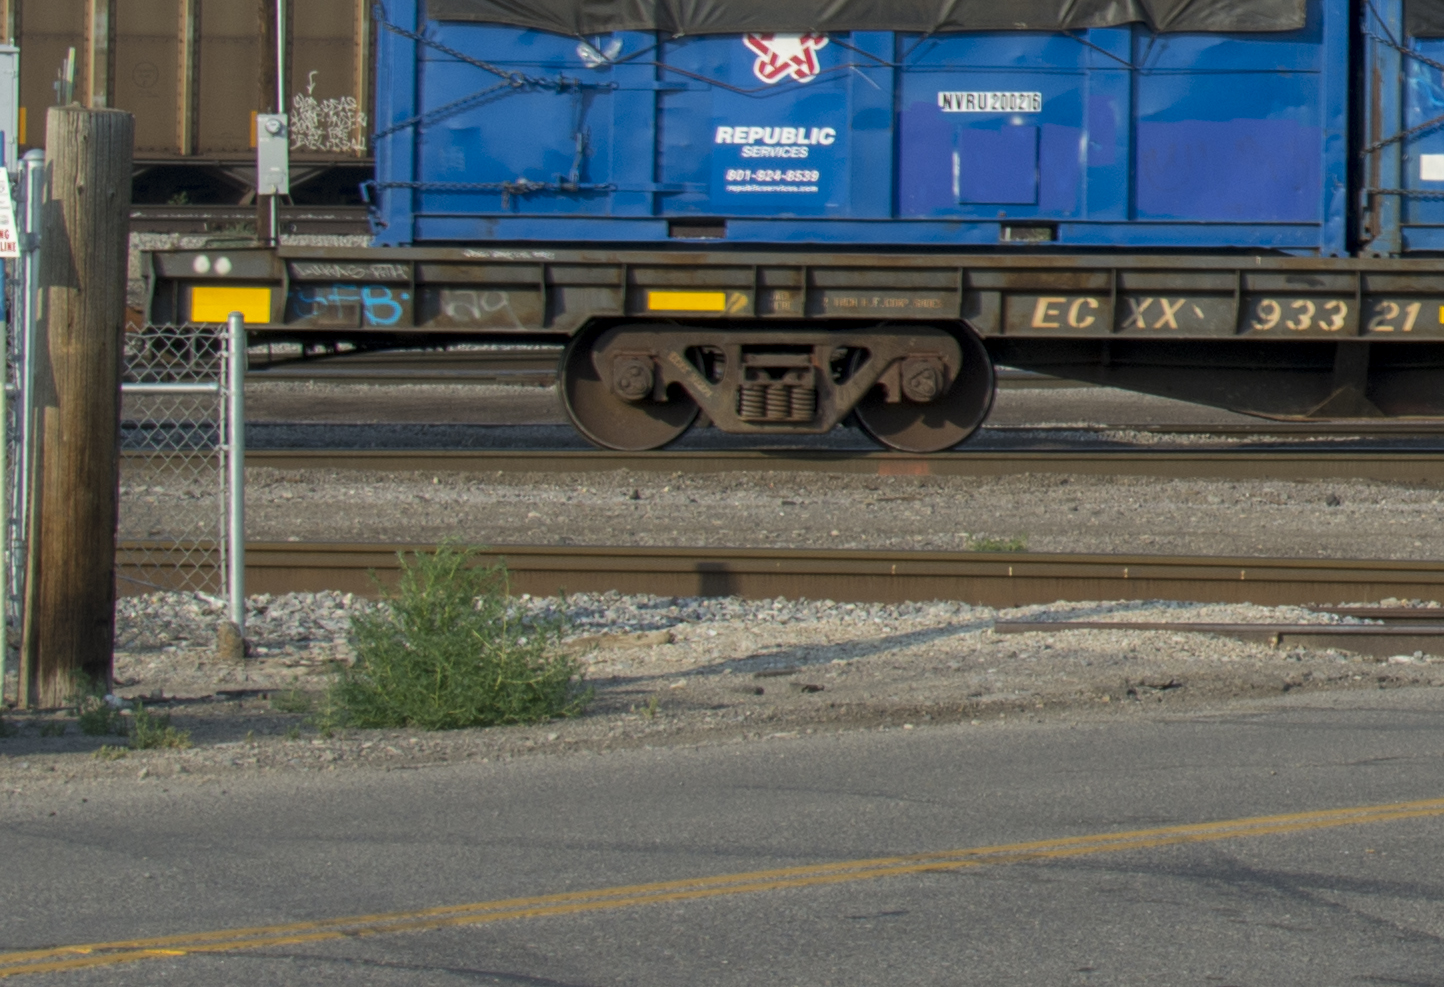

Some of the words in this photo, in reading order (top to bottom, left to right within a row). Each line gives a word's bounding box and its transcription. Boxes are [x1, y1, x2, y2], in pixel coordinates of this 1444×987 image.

[942, 93, 988, 110] NVRU
[714, 126, 837, 146] REPUBLIC
[741, 145, 809, 158] SERVICES
